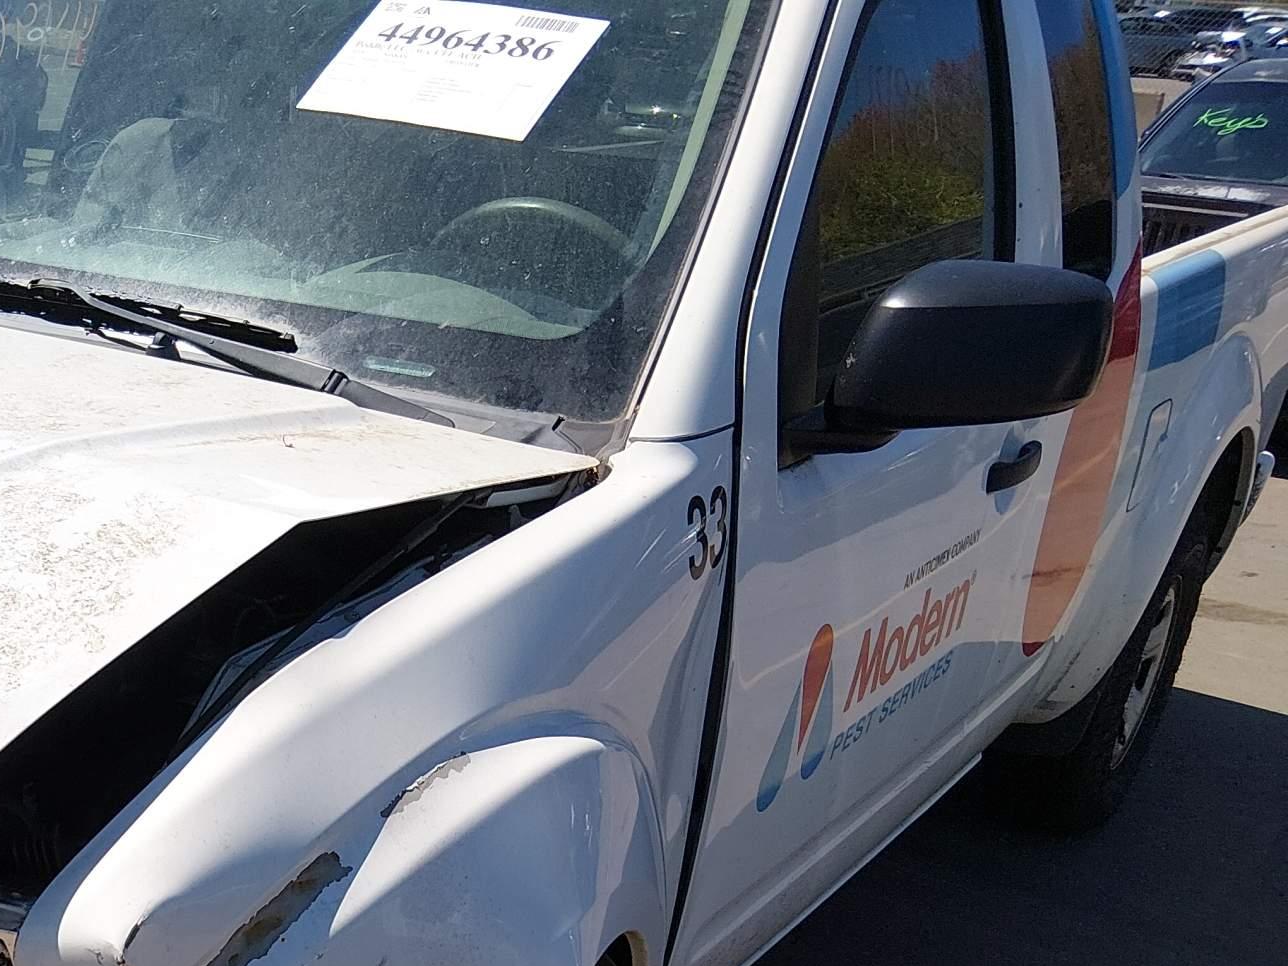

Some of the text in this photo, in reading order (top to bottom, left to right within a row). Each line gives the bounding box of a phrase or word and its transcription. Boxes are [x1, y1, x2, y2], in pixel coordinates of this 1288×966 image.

[378, 22, 562, 61] 44964386
[1192, 107, 1269, 136] Keys
[686, 485, 728, 581] 33
[829, 650, 955, 761] PEST SERVICES
